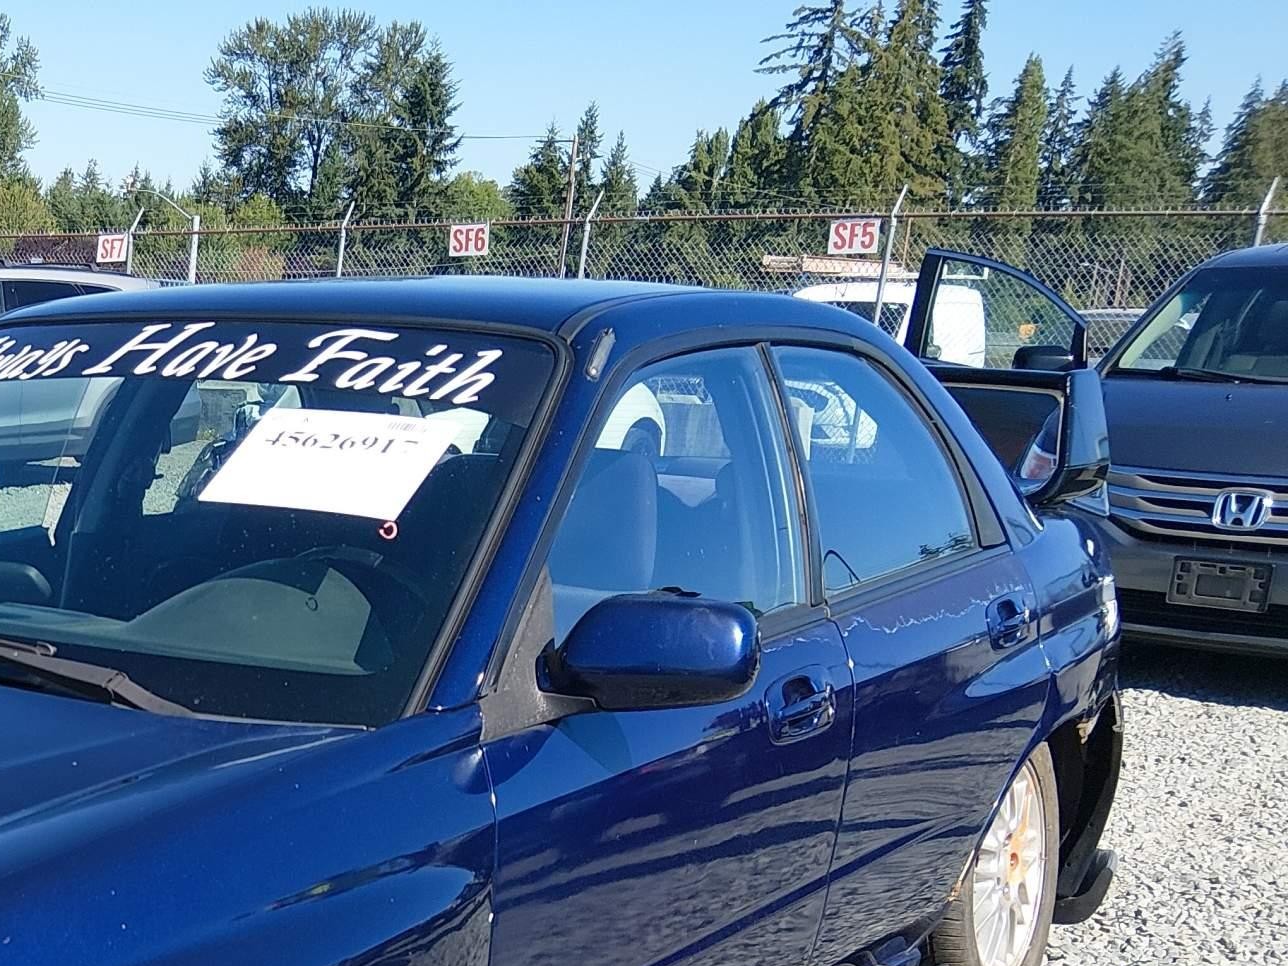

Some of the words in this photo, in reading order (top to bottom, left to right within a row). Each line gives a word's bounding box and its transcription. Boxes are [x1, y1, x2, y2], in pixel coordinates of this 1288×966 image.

[101, 237, 124, 259] SF7
[452, 227, 486, 253] SF6
[833, 221, 875, 250] SF5
[81, 321, 278, 380] Have
[278, 327, 504, 404] Faith
